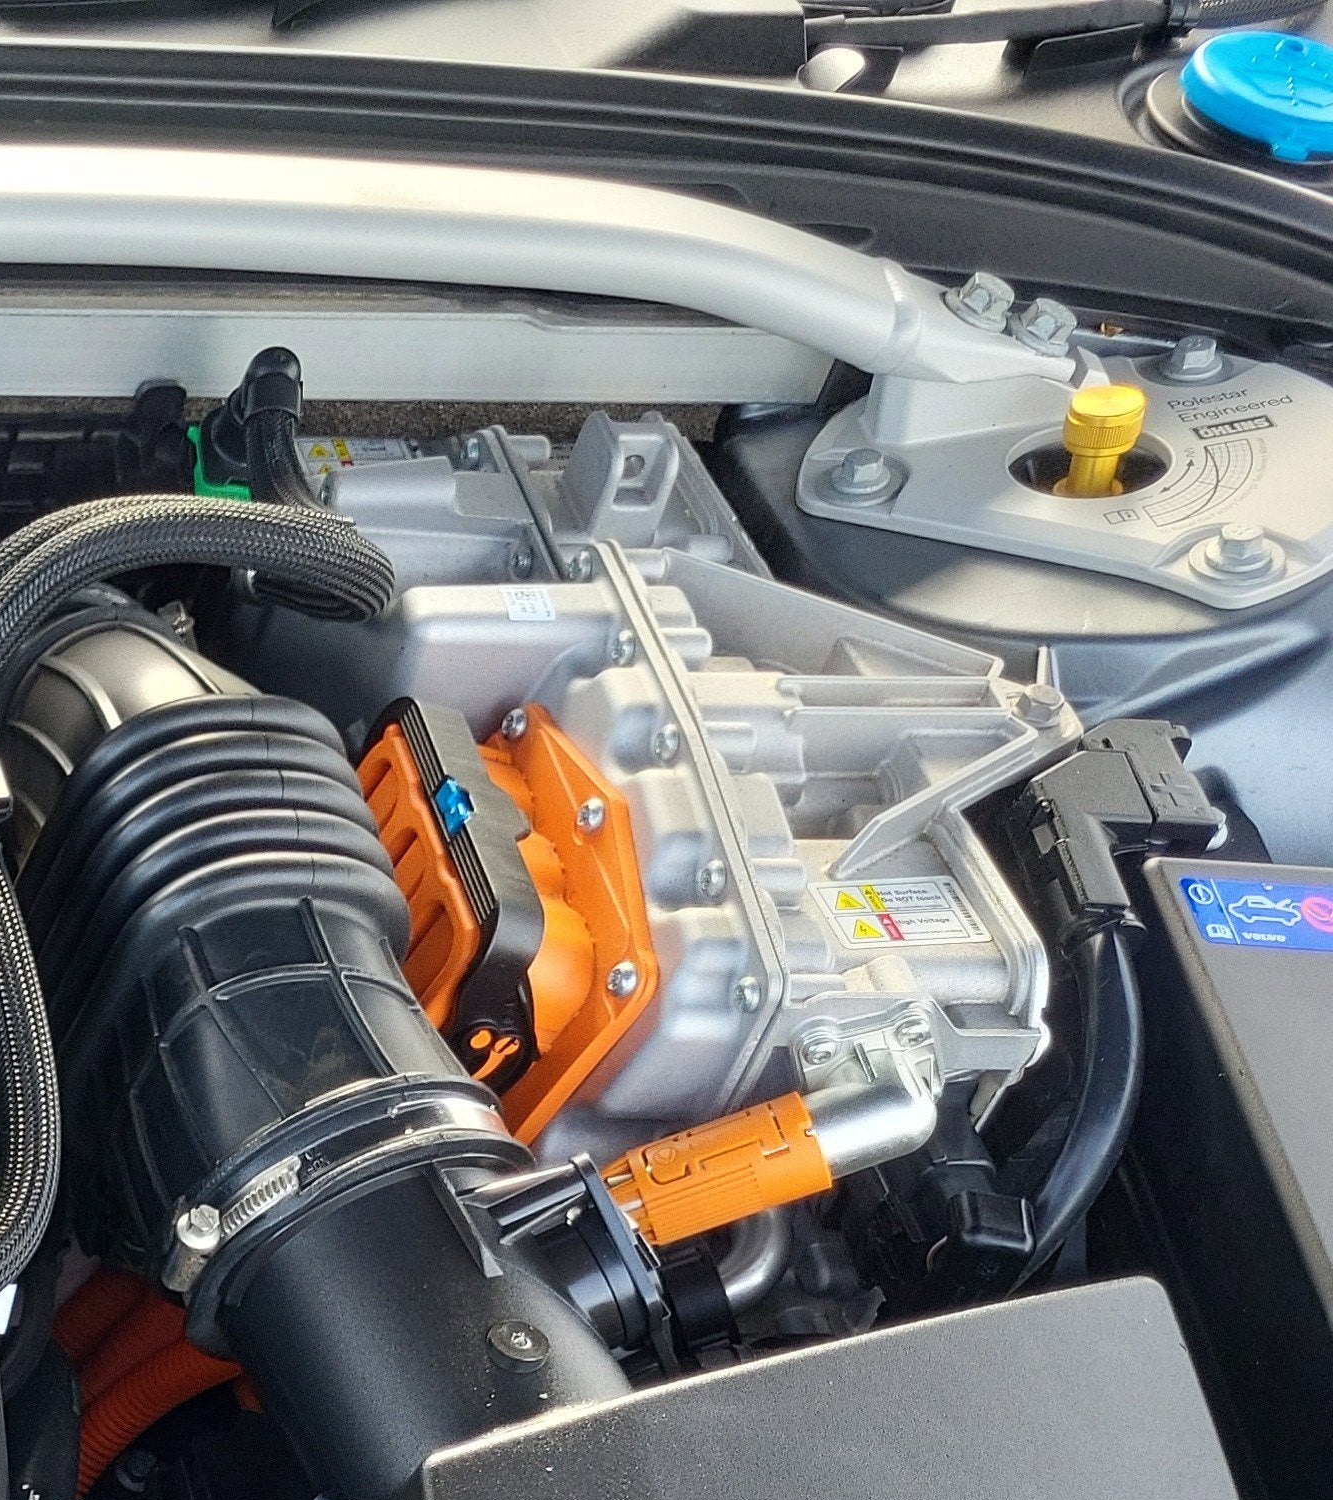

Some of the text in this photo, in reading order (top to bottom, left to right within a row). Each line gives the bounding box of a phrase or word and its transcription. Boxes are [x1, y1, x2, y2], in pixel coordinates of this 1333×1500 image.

[1167, 389, 1248, 410] Polestar
[1178, 395, 1293, 423] Engineered
[1191, 415, 1275, 440] ÖHLINS
